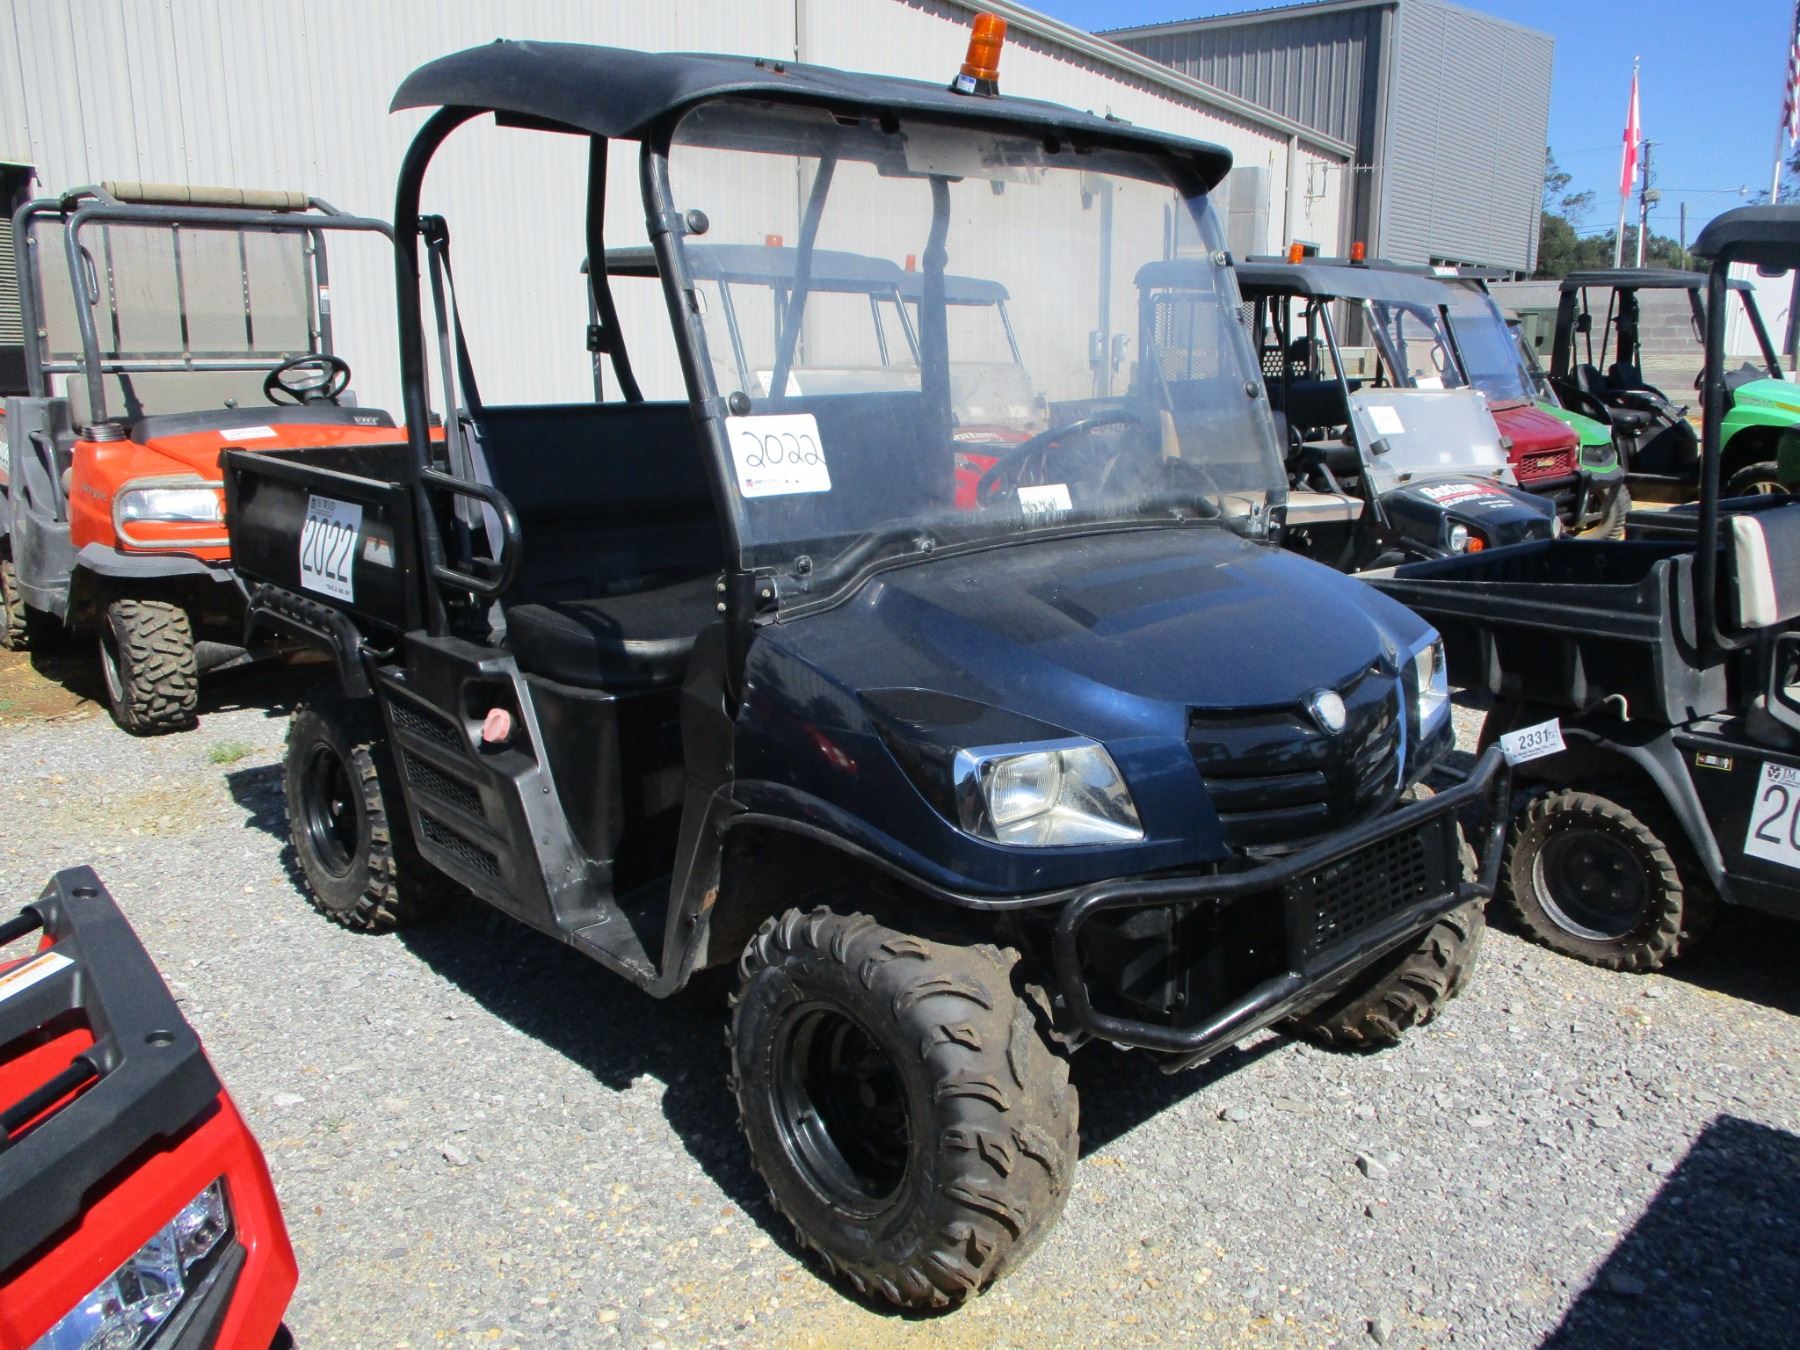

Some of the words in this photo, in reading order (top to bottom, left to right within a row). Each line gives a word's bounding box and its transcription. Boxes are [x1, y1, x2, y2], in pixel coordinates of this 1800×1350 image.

[742, 431, 826, 468] 2022
[302, 514, 353, 584] 2022
[1518, 728, 1549, 751] 2331
